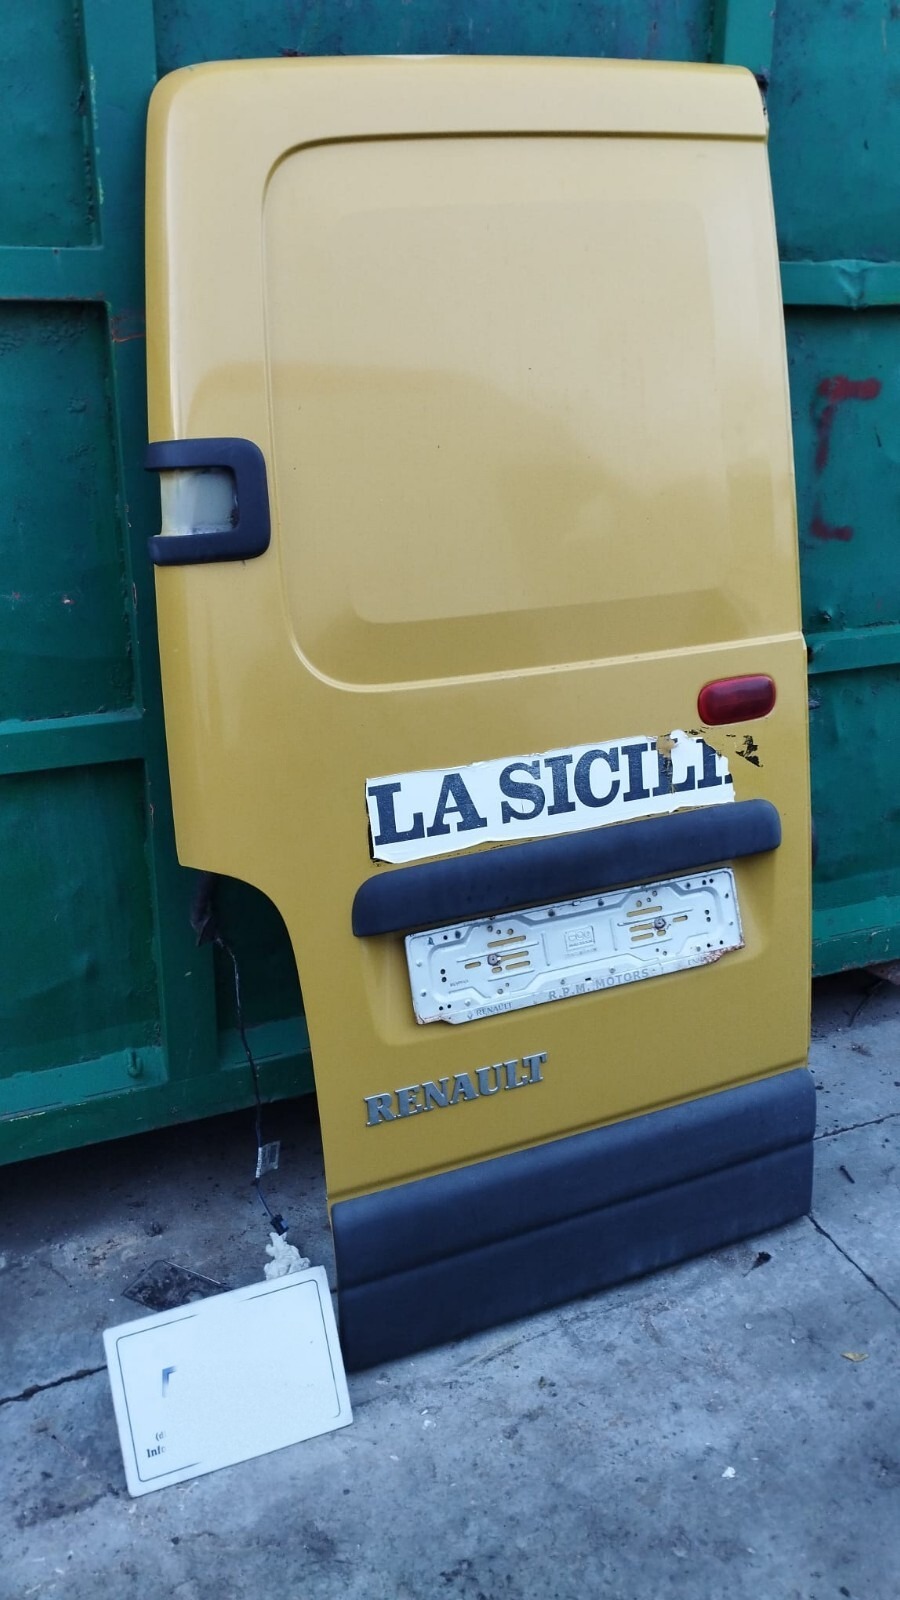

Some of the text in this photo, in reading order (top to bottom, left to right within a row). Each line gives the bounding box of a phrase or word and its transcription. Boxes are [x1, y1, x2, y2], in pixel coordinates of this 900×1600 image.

[369, 739, 733, 845] LA SICILI
[476, 1002, 513, 1016] RENAULT
[364, 1051, 548, 1127] RENAULT
